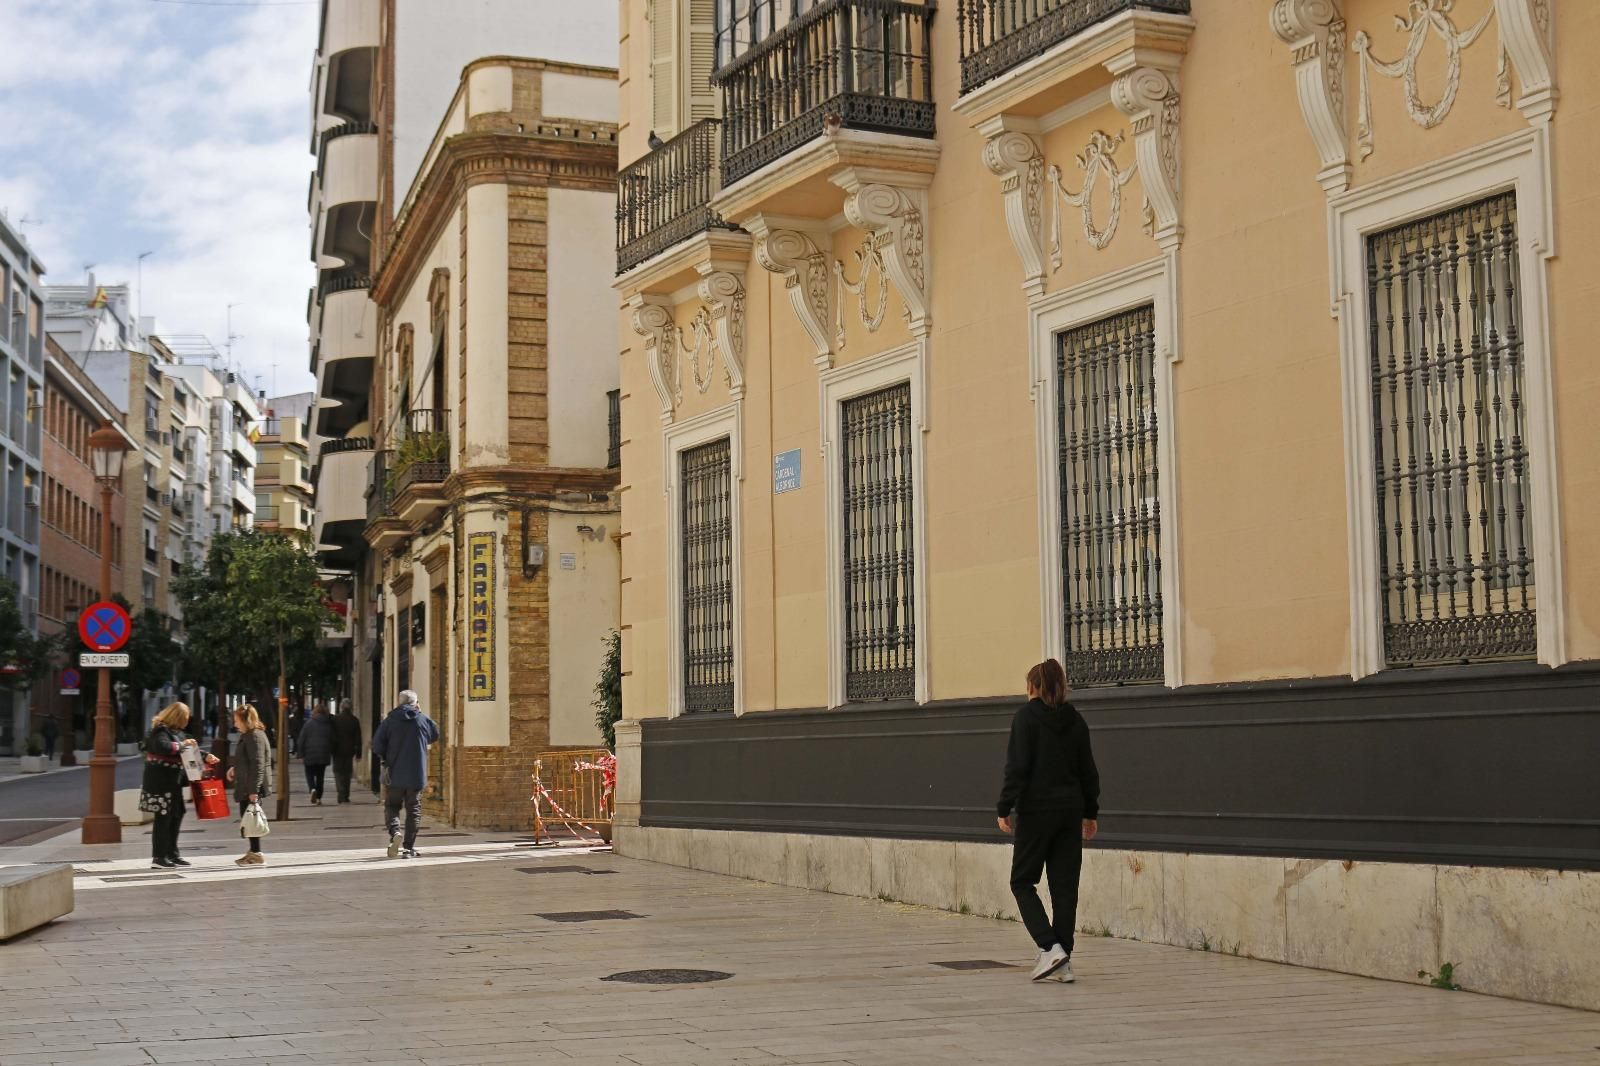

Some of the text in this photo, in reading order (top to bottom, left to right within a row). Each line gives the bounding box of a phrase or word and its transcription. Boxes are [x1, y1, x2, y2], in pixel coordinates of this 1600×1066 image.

[473, 543, 487, 690] FARMACIA
[81, 655, 91, 664] EN
[101, 655, 128, 664] PUERTO
